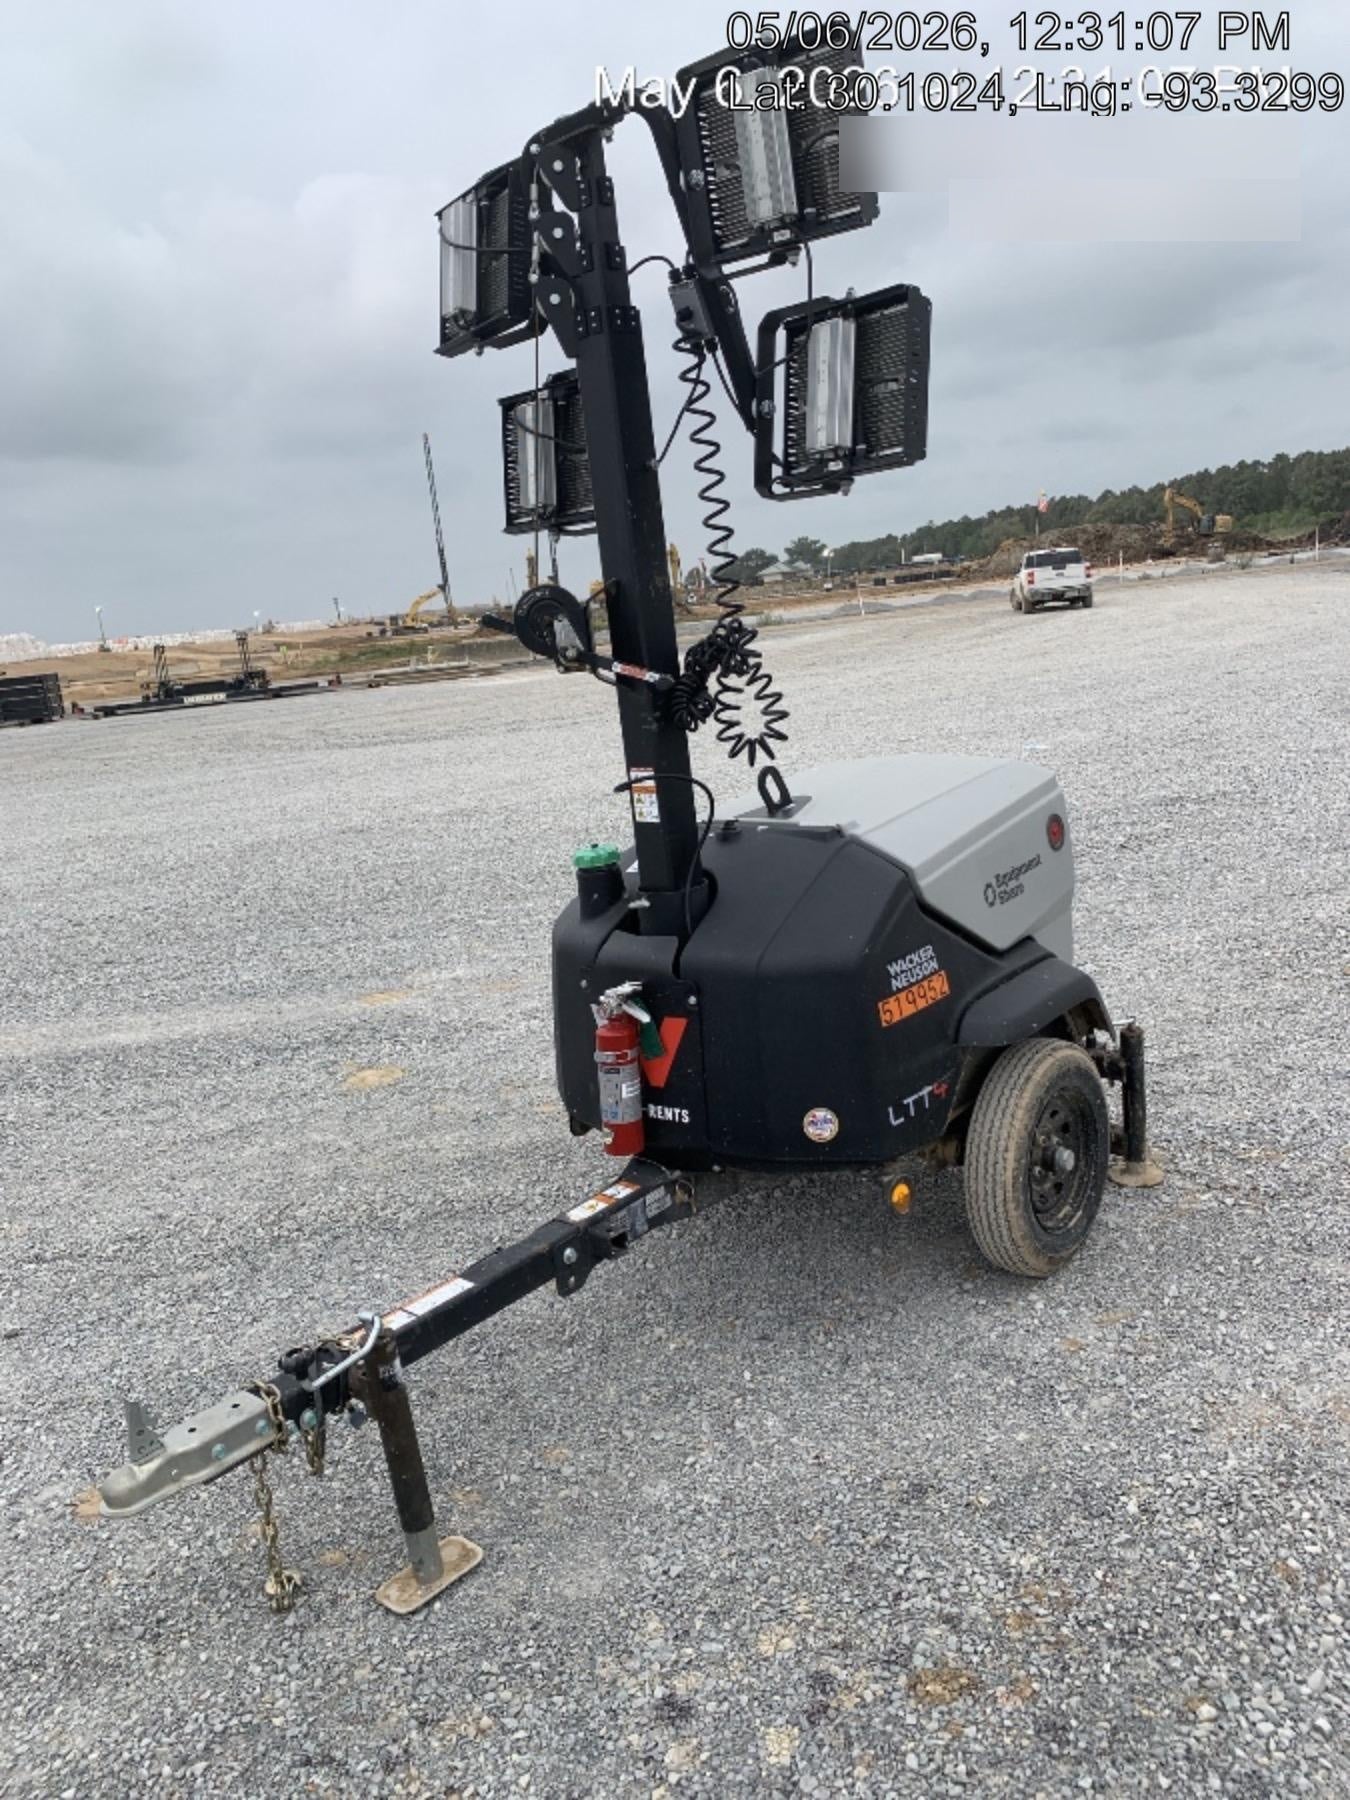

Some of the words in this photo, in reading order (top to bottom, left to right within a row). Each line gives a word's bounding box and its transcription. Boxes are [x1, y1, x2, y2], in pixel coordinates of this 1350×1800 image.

[886, 945, 935, 977] WACKER
[890, 957, 939, 991] NEUSON
[881, 972, 947, 1025] 519952
[648, 1104, 690, 1123] RENTS
